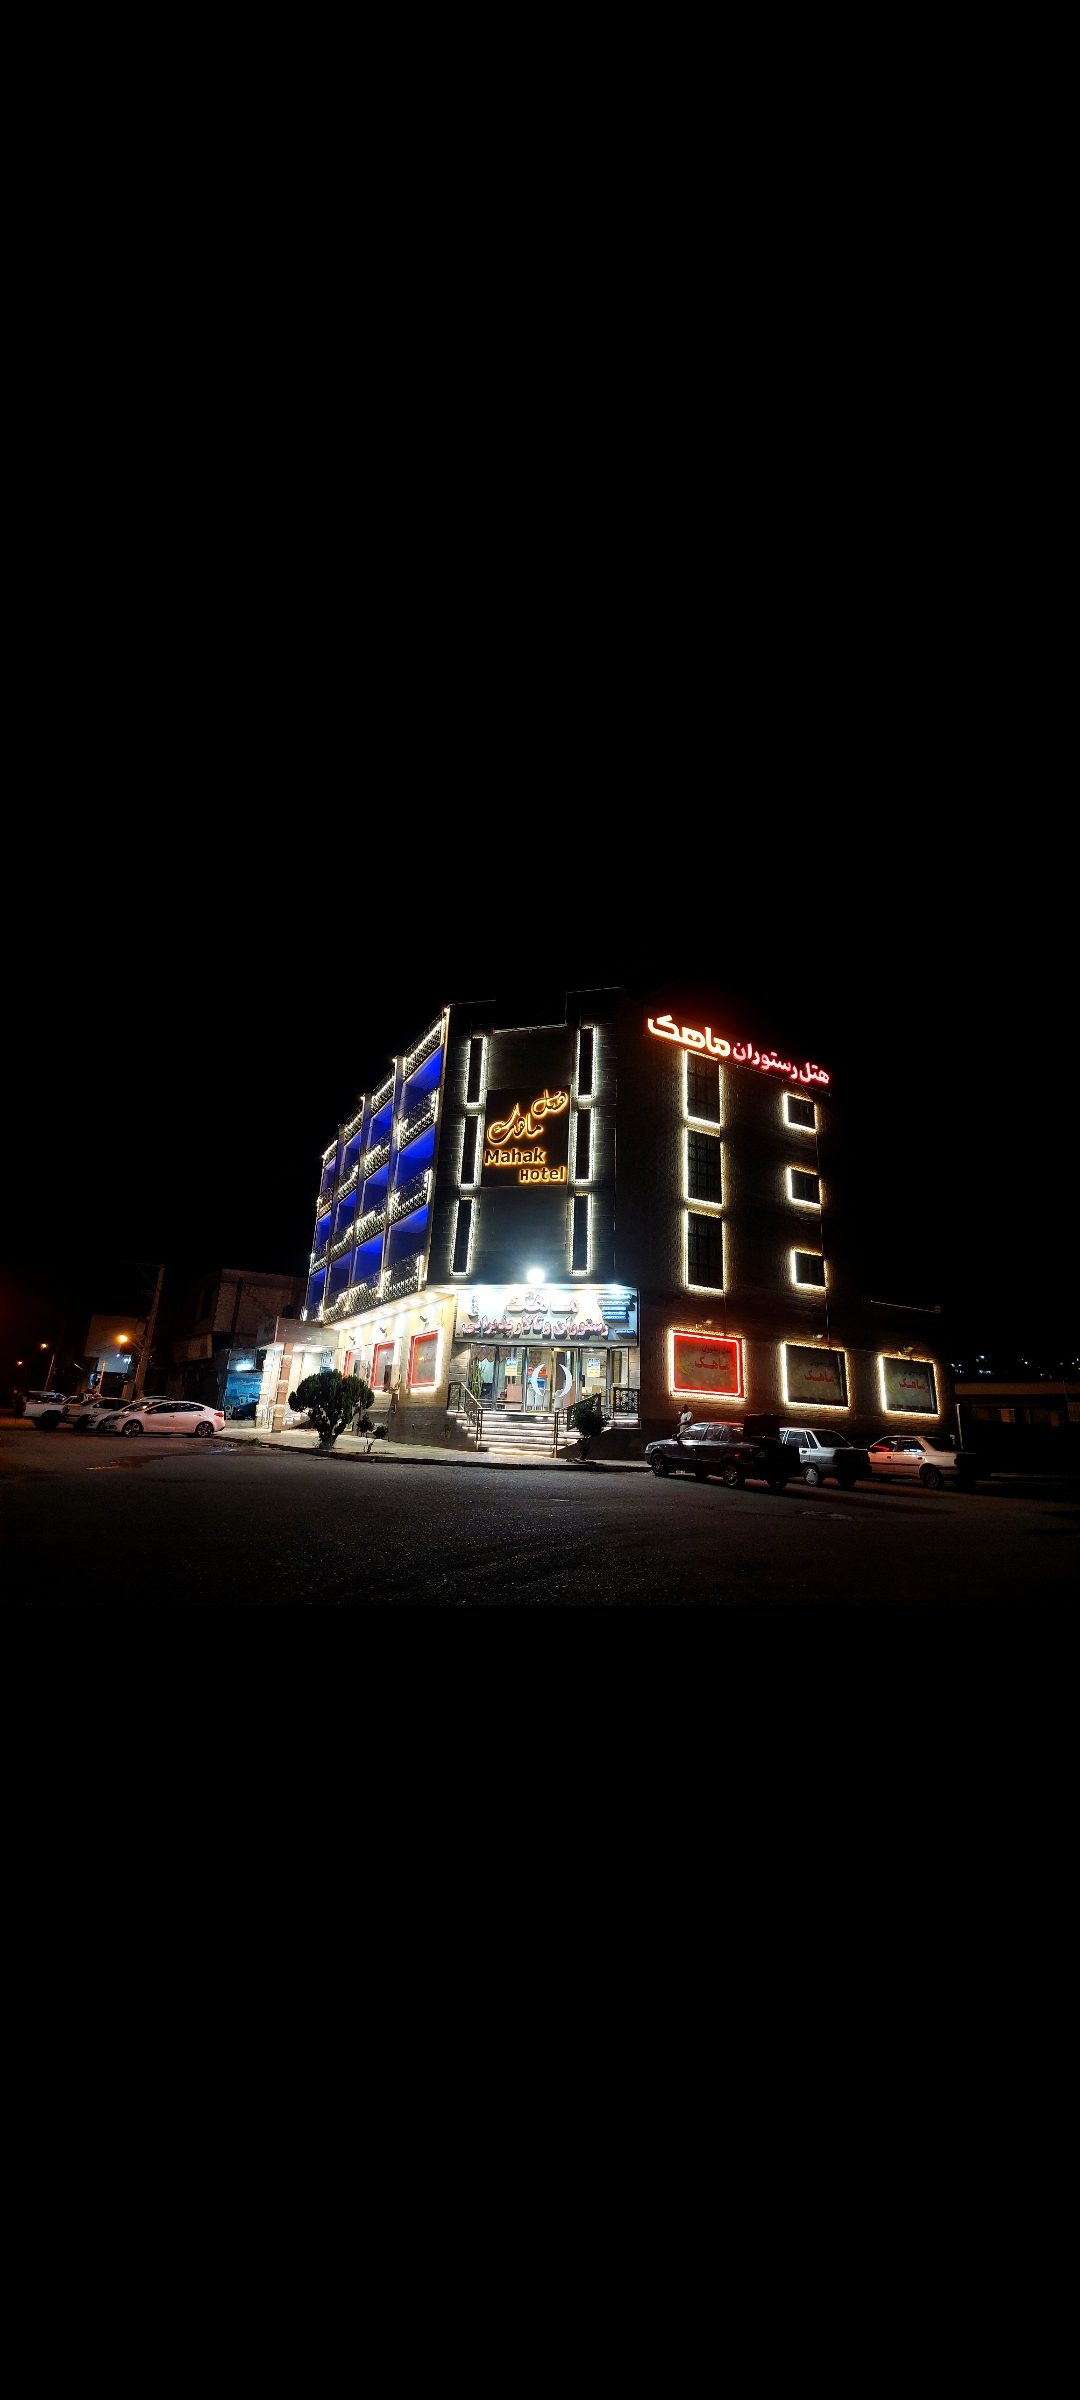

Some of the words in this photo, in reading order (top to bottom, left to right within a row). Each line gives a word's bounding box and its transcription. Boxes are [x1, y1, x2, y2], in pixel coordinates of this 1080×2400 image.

[647, 1015, 730, 1056] ماهک
[733, 1043, 798, 1078] رستوران
[799, 1062, 830, 1085] هتل
[484, 1147, 546, 1166] Mahak
[519, 1166, 566, 1182] Hotel
[694, 1356, 730, 1371] ماهک
